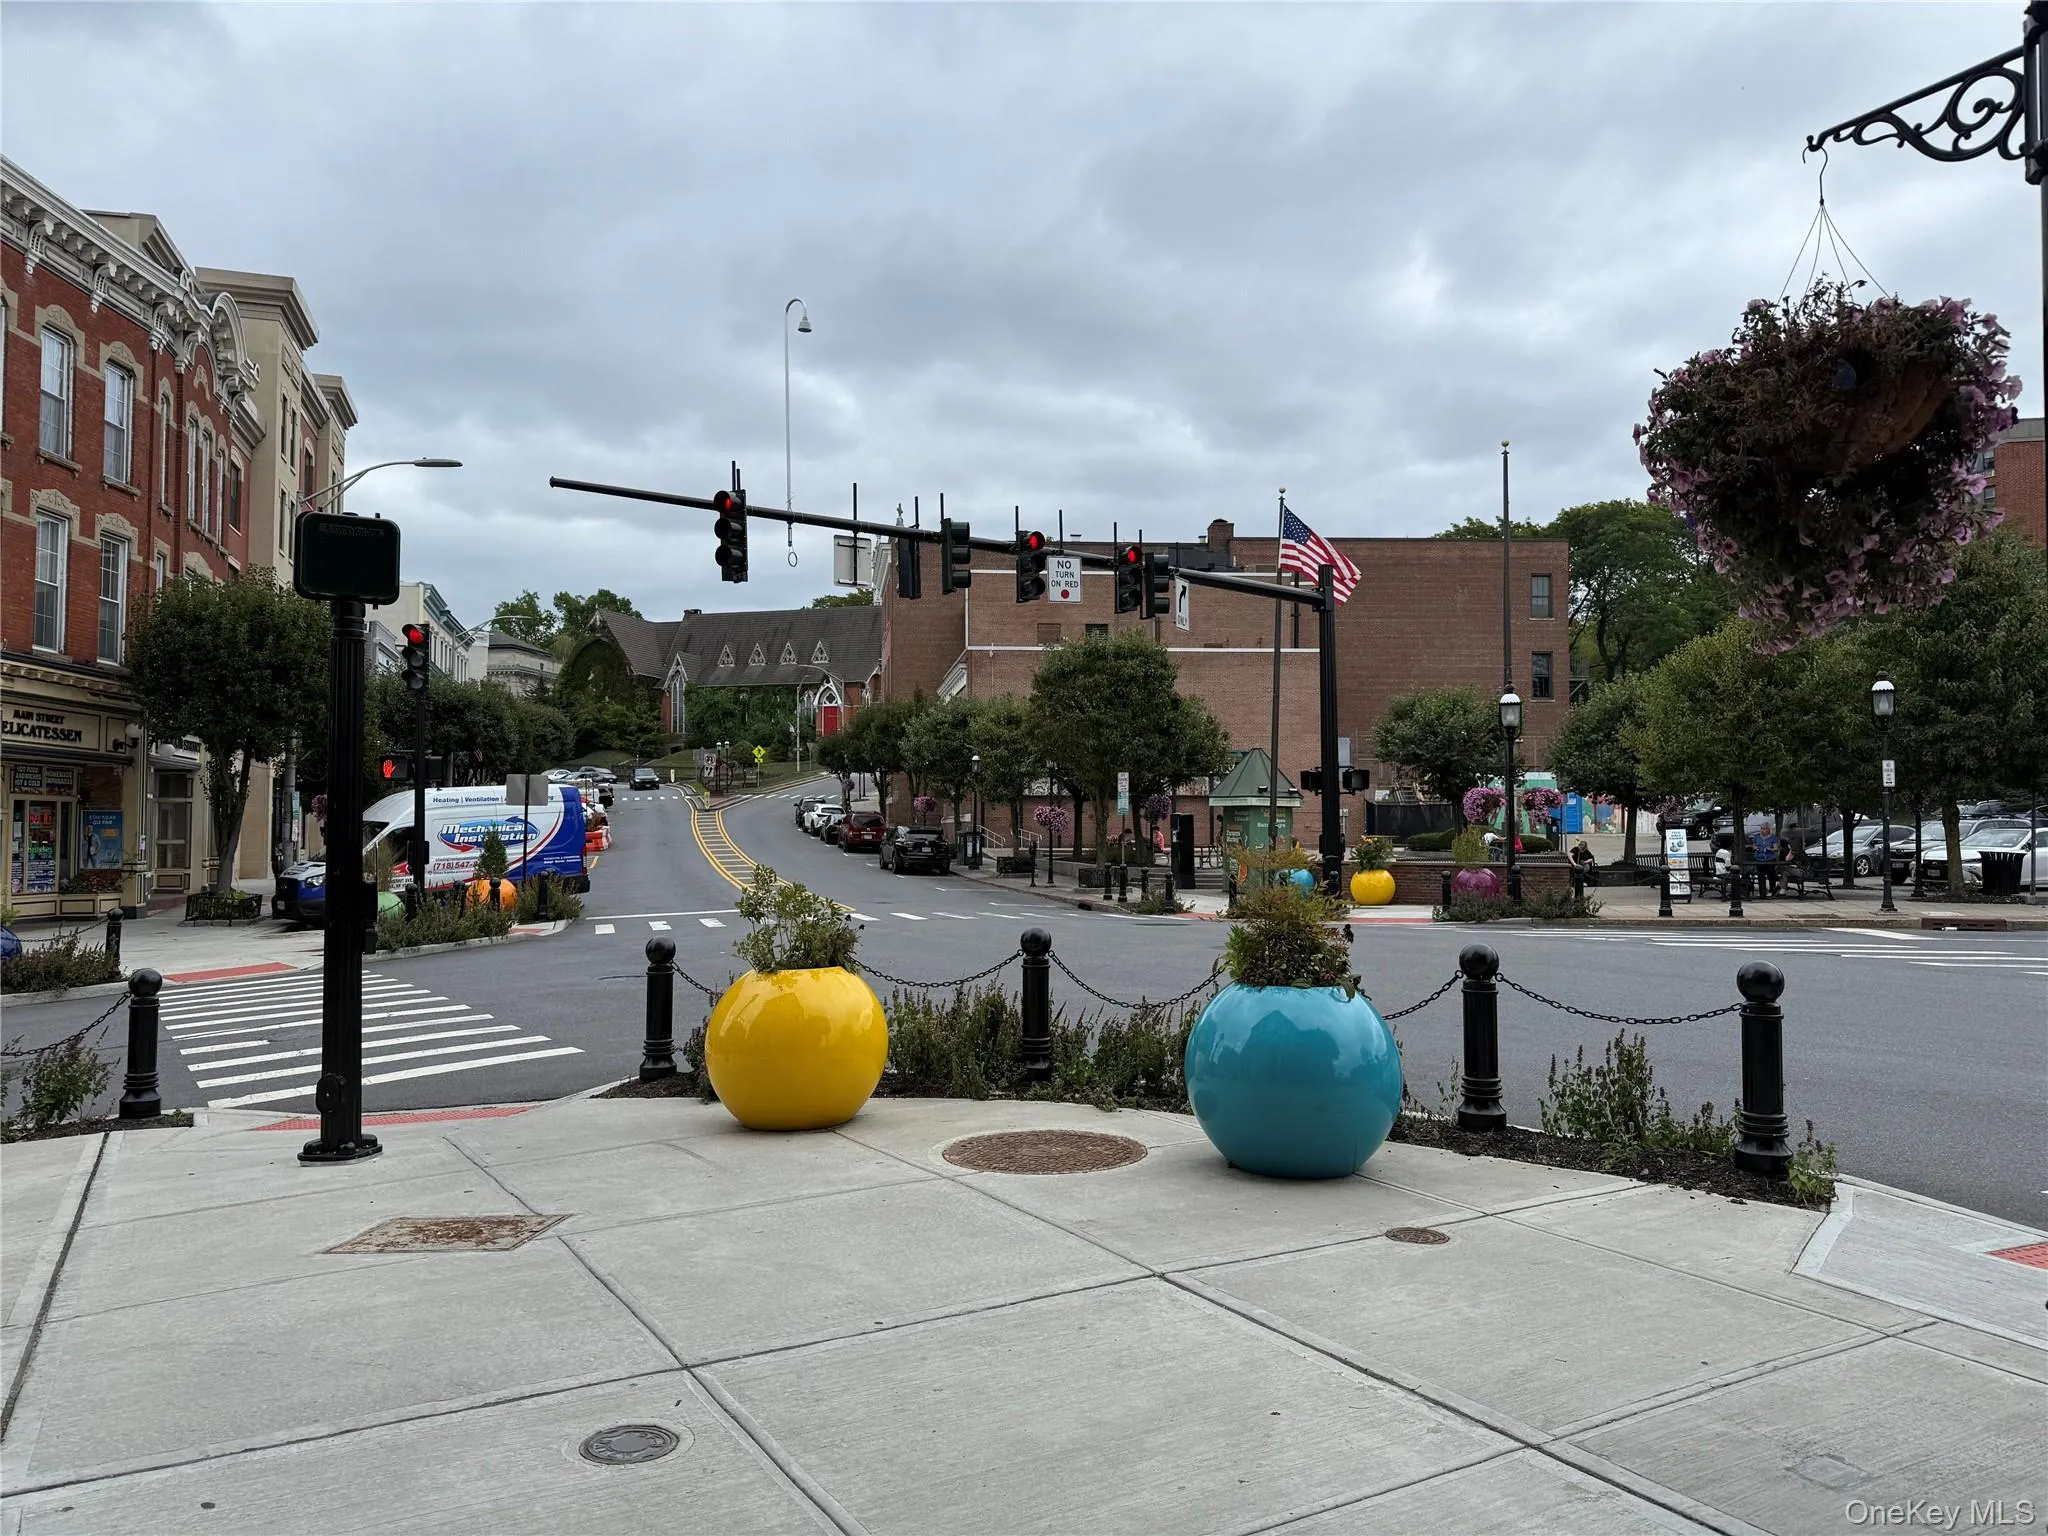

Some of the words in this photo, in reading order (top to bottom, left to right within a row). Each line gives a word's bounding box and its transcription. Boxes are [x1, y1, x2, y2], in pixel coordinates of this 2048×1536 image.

[1057, 560, 1072, 570] NO
[1055, 570, 1075, 579] TURN
[1051, 580, 1061, 588] ON
[1064, 580, 1079, 588] RED
[1177, 614, 1188, 627] ONLY
[13, 709, 34, 720] MAIN
[35, 712, 65, 724] STREET
[433, 862, 454, 871] (718)
